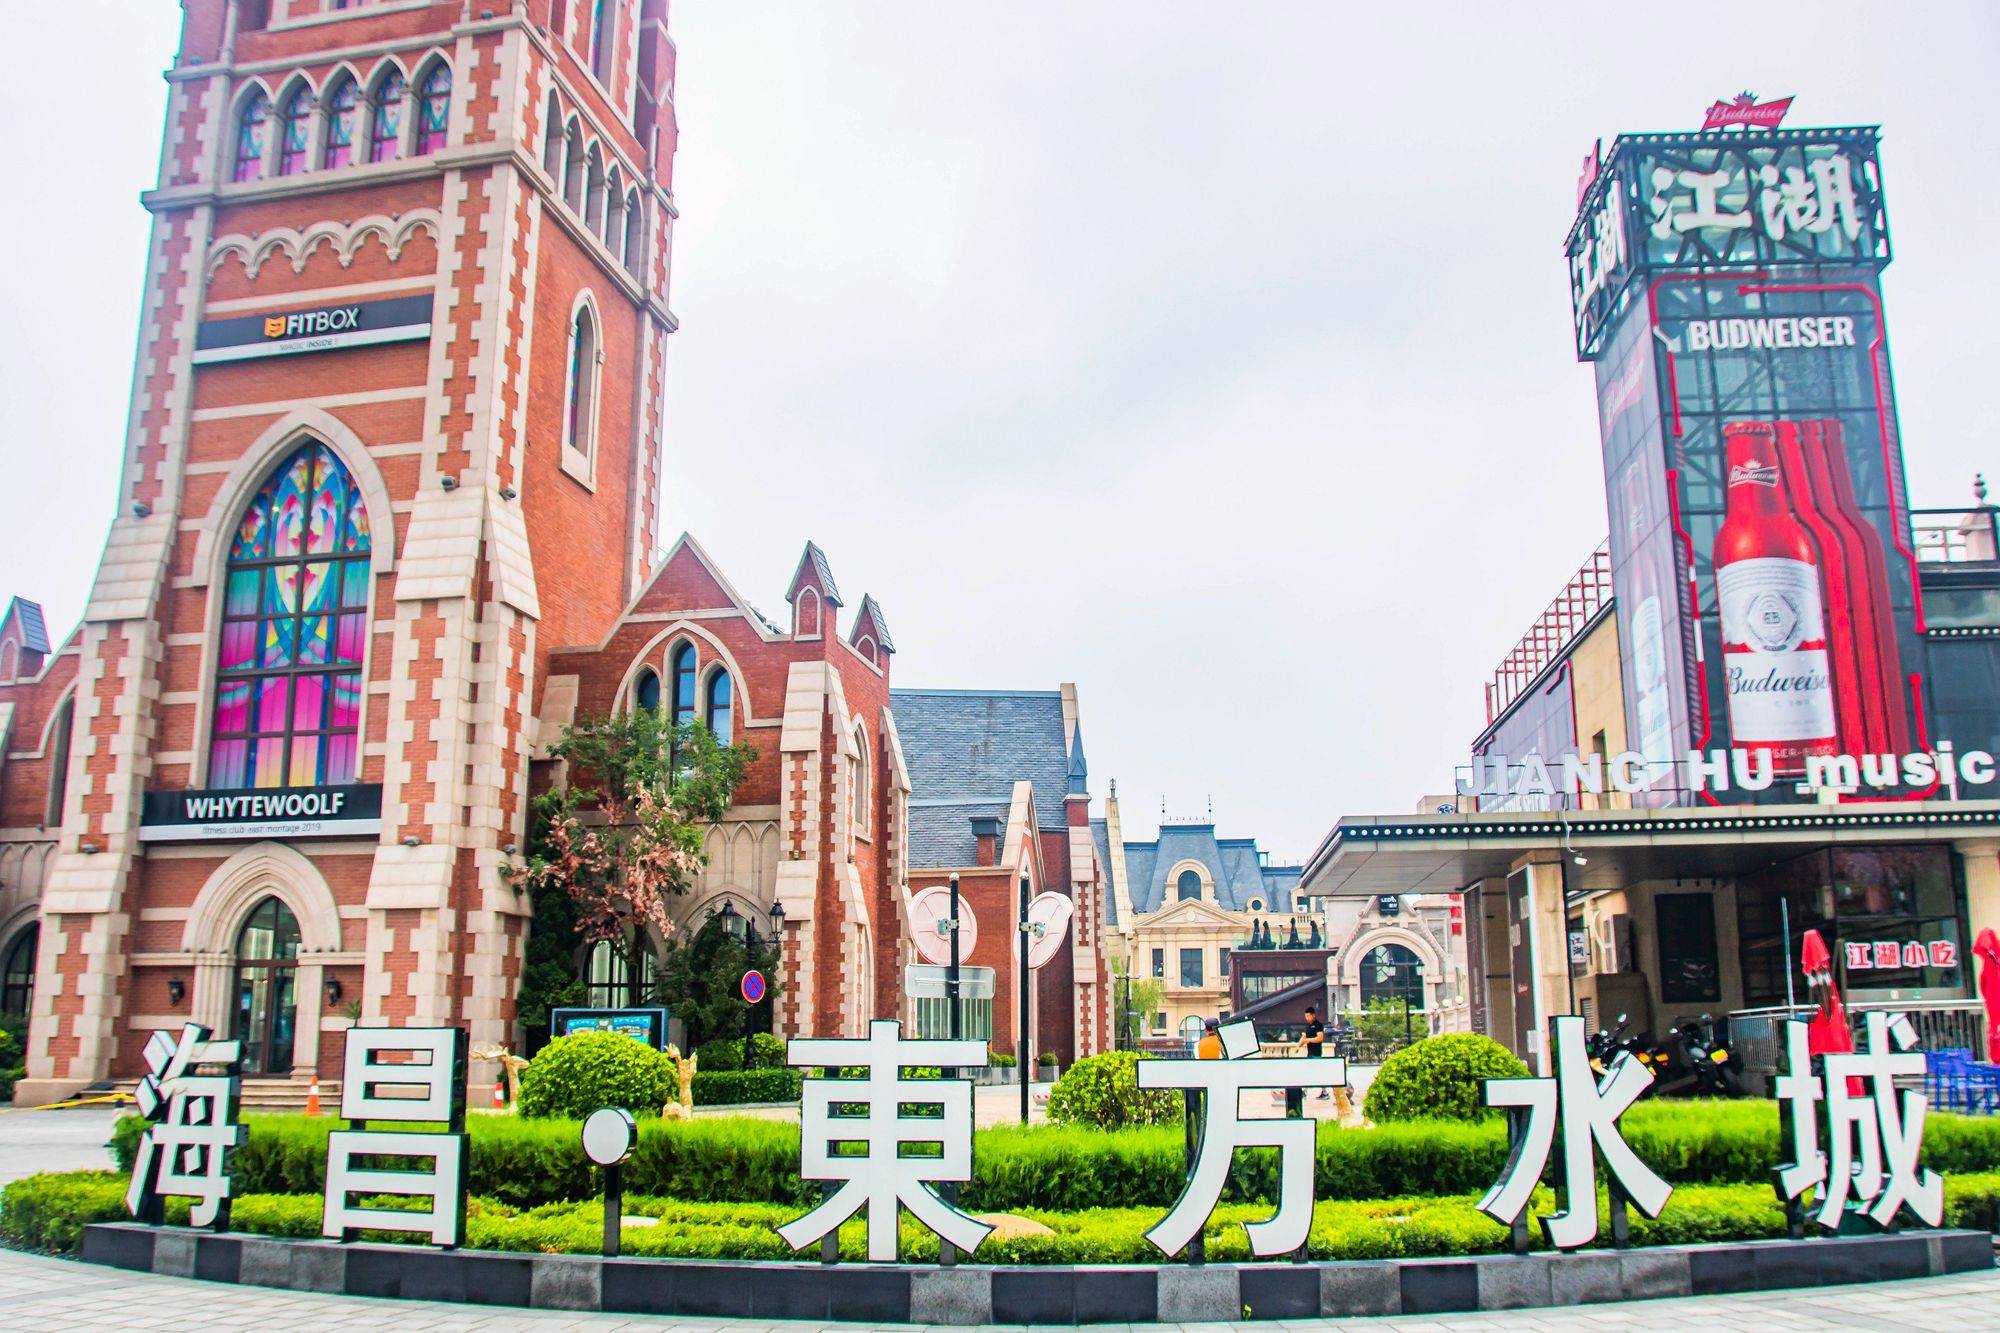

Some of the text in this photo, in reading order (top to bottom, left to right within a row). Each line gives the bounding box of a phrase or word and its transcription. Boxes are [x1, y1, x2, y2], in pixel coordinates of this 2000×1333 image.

[1650, 152, 1864, 242] 江湖
[287, 307, 360, 336] FITBOX
[1687, 316, 1856, 352] BUDWEISER
[1456, 740, 1996, 797] JIANG HU music
[185, 792, 344, 819] WHYTEWOOLF
[1845, 940, 1958, 969] 江湖小吃
